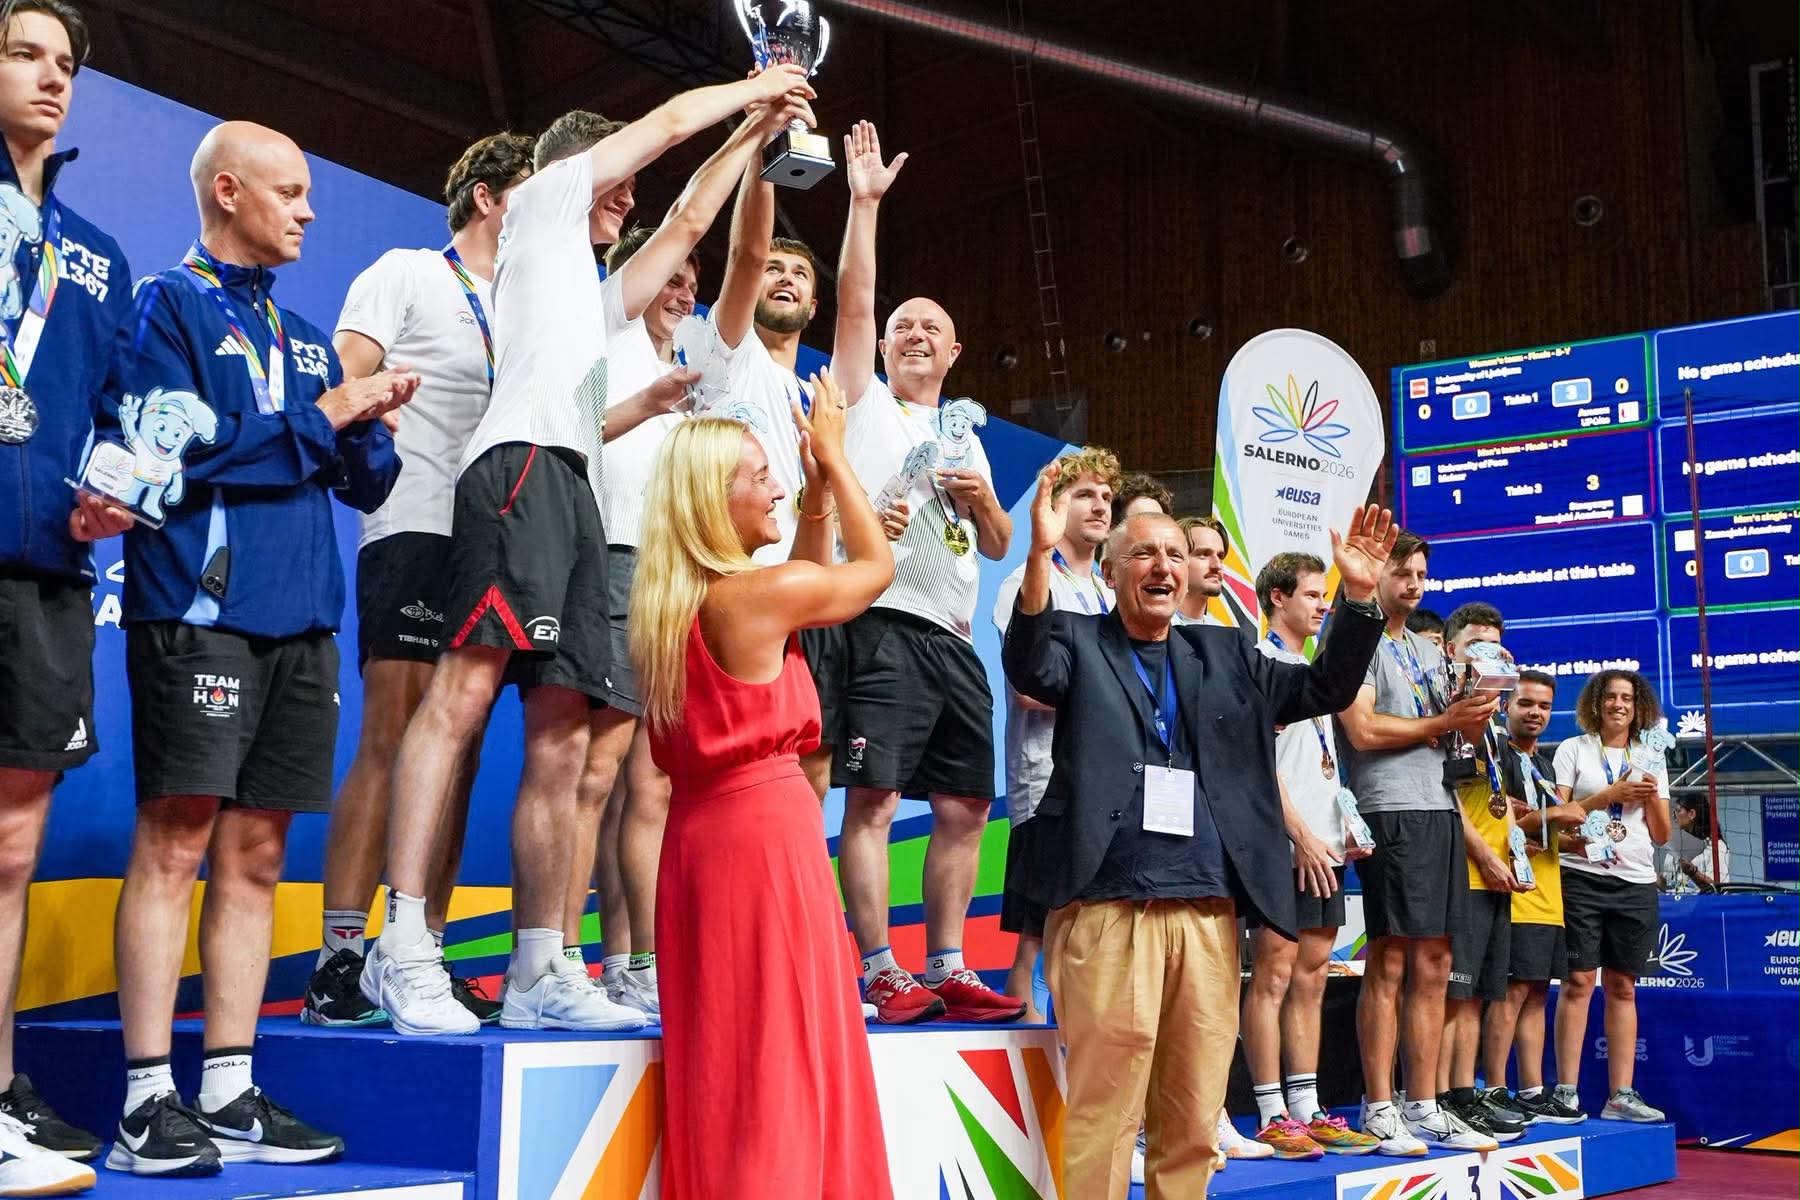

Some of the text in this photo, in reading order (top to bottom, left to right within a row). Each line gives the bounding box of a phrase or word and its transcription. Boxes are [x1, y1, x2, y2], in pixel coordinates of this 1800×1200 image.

[62, 237, 111, 281] PTE
[58, 258, 109, 303] 1367
[293, 354, 329, 380] 136
[1678, 366, 1700, 380] No
[1700, 361, 1743, 380] game
[1615, 378, 1629, 394] 0
[1503, 392, 1538, 406] Table 1
[1418, 404, 1431, 420] 0
[1682, 461, 1704, 475] No
[1705, 457, 1747, 475] game
[1505, 484, 1534, 496] Table
[1586, 474, 1599, 491] 3
[1285, 486, 1321, 506] eusa
[1453, 489, 1461, 505] 1
[1278, 508, 1318, 522] EUROPEAN
[1272, 517, 1322, 532] UNIVERSITIES
[1283, 529, 1310, 540] GAMES
[1424, 562, 1636, 593] No game scheduled at this table
[1557, 661, 1572, 675] at
[1573, 659, 1602, 675] this
[1602, 657, 1639, 672] table
[1692, 653, 1713, 668] No
[1714, 653, 1757, 669] game
[194, 674, 240, 690] TEAM
[1634, 976, 1705, 988] LERNO2026
[203, 1060, 248, 1071] JOOLA
[1468, 1165, 1481, 1200] 3
